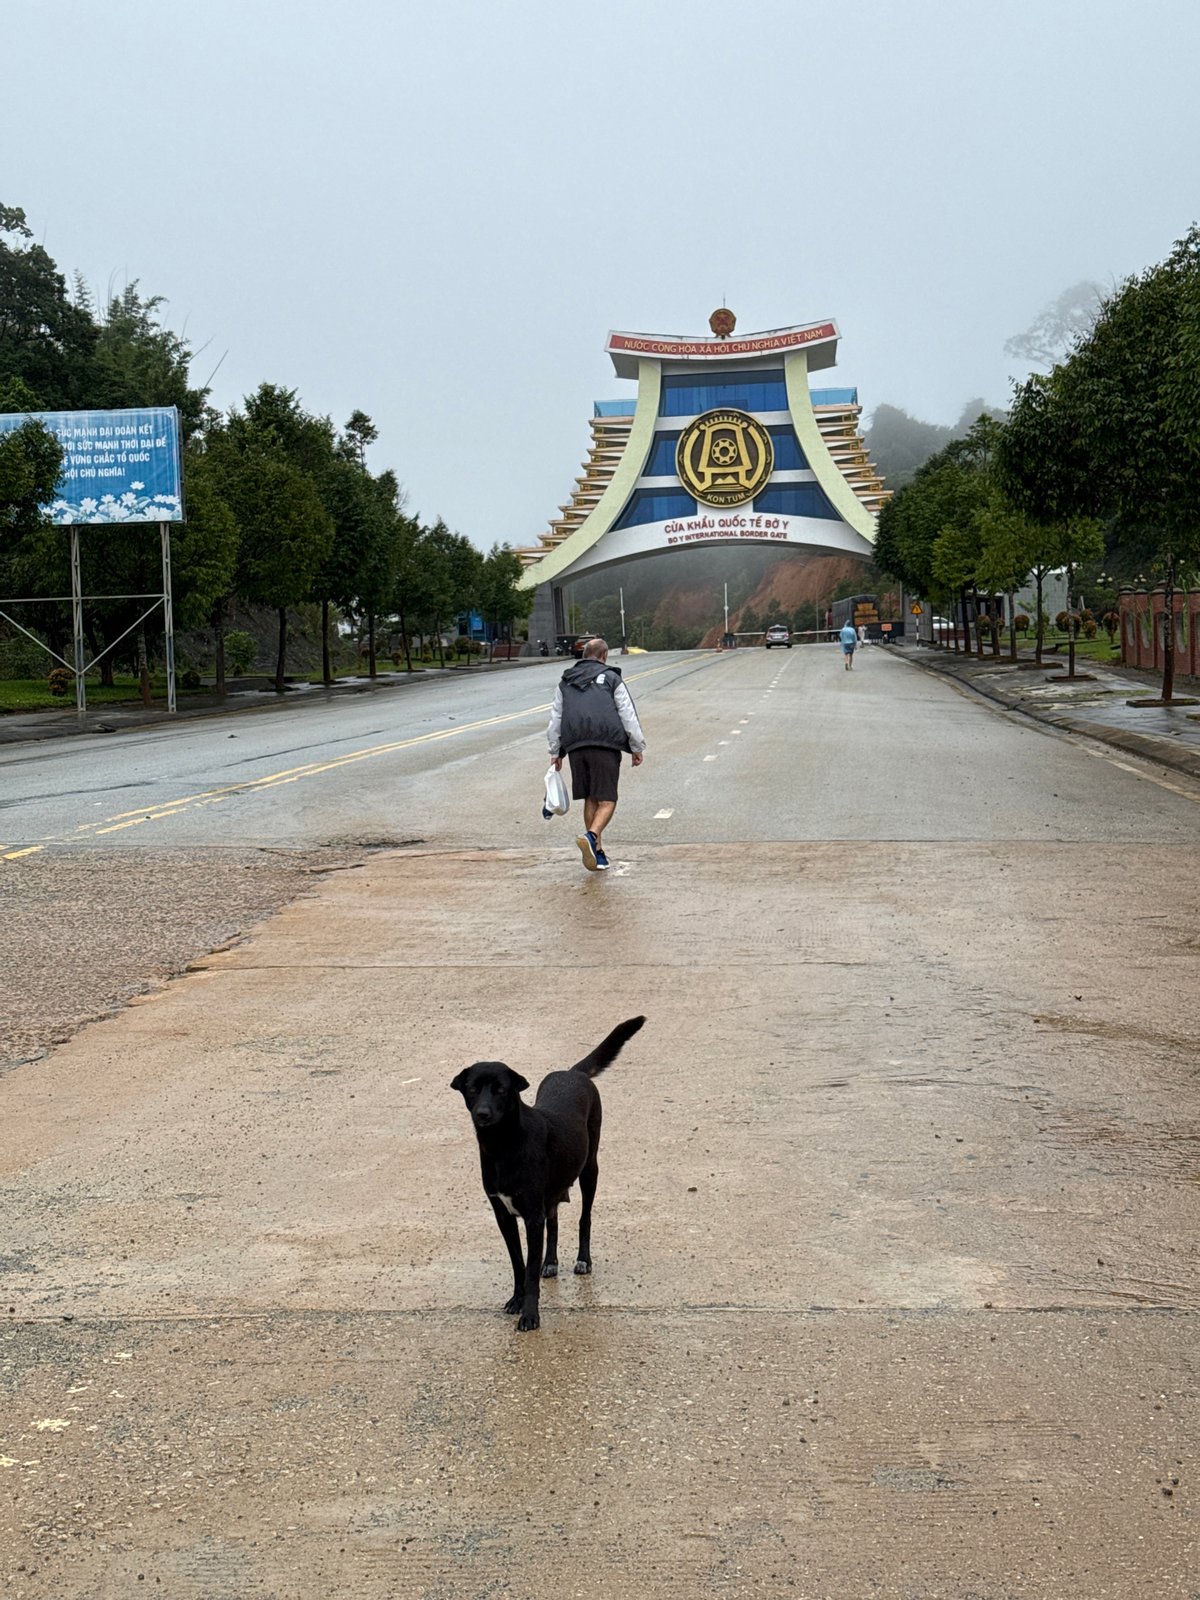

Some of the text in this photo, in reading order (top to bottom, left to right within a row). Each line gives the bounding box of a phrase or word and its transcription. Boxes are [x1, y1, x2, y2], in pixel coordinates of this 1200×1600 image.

[804, 329, 823, 340] NAM
[77, 439, 93, 450] SỨC
[95, 440, 119, 451] MẠNH
[128, 450, 150, 462] QUỐC
[706, 492, 746, 503] KON TUM
[664, 514, 789, 534] CỬA KHẨU QUỐC TẾ BỜ Y
[668, 536, 678, 544] BO
[685, 530, 738, 541] INTERNATIONAL
[740, 530, 768, 538] BORDER
